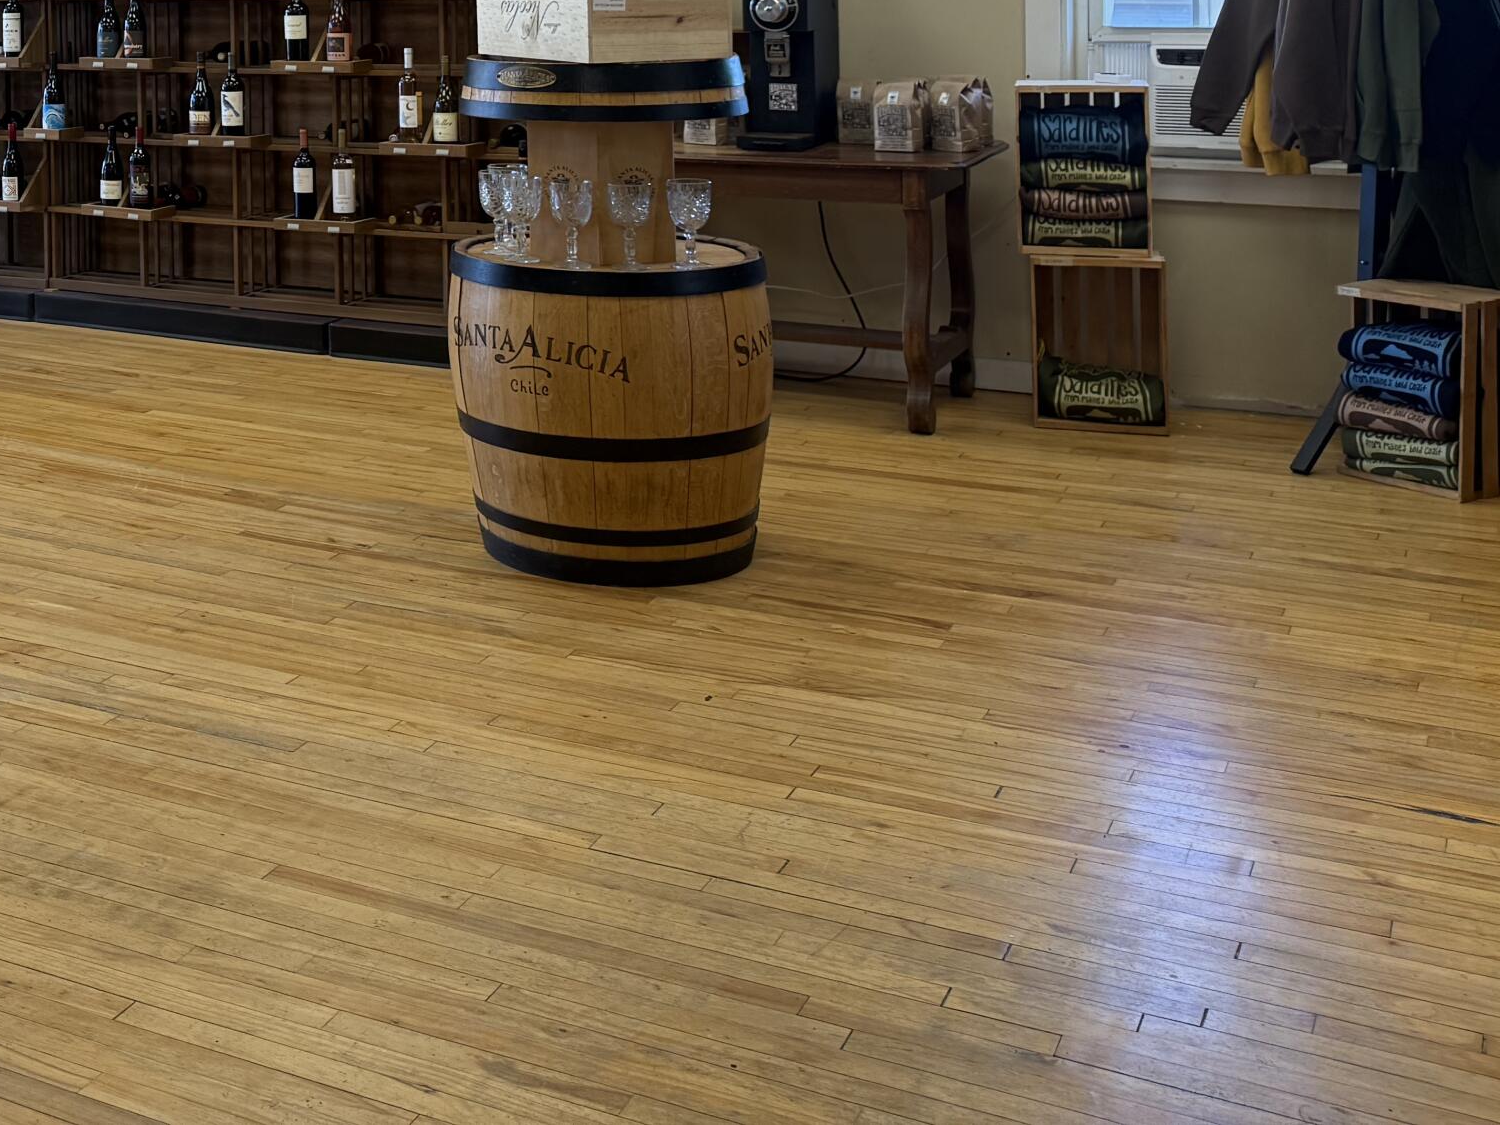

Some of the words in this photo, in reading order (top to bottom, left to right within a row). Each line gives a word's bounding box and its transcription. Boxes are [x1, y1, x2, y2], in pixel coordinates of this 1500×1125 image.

[501, 0, 561, 41] Nicolas
[454, 315, 515, 352] SANTA
[494, 324, 630, 383] ALICIA
[734, 323, 774, 368] SAN
